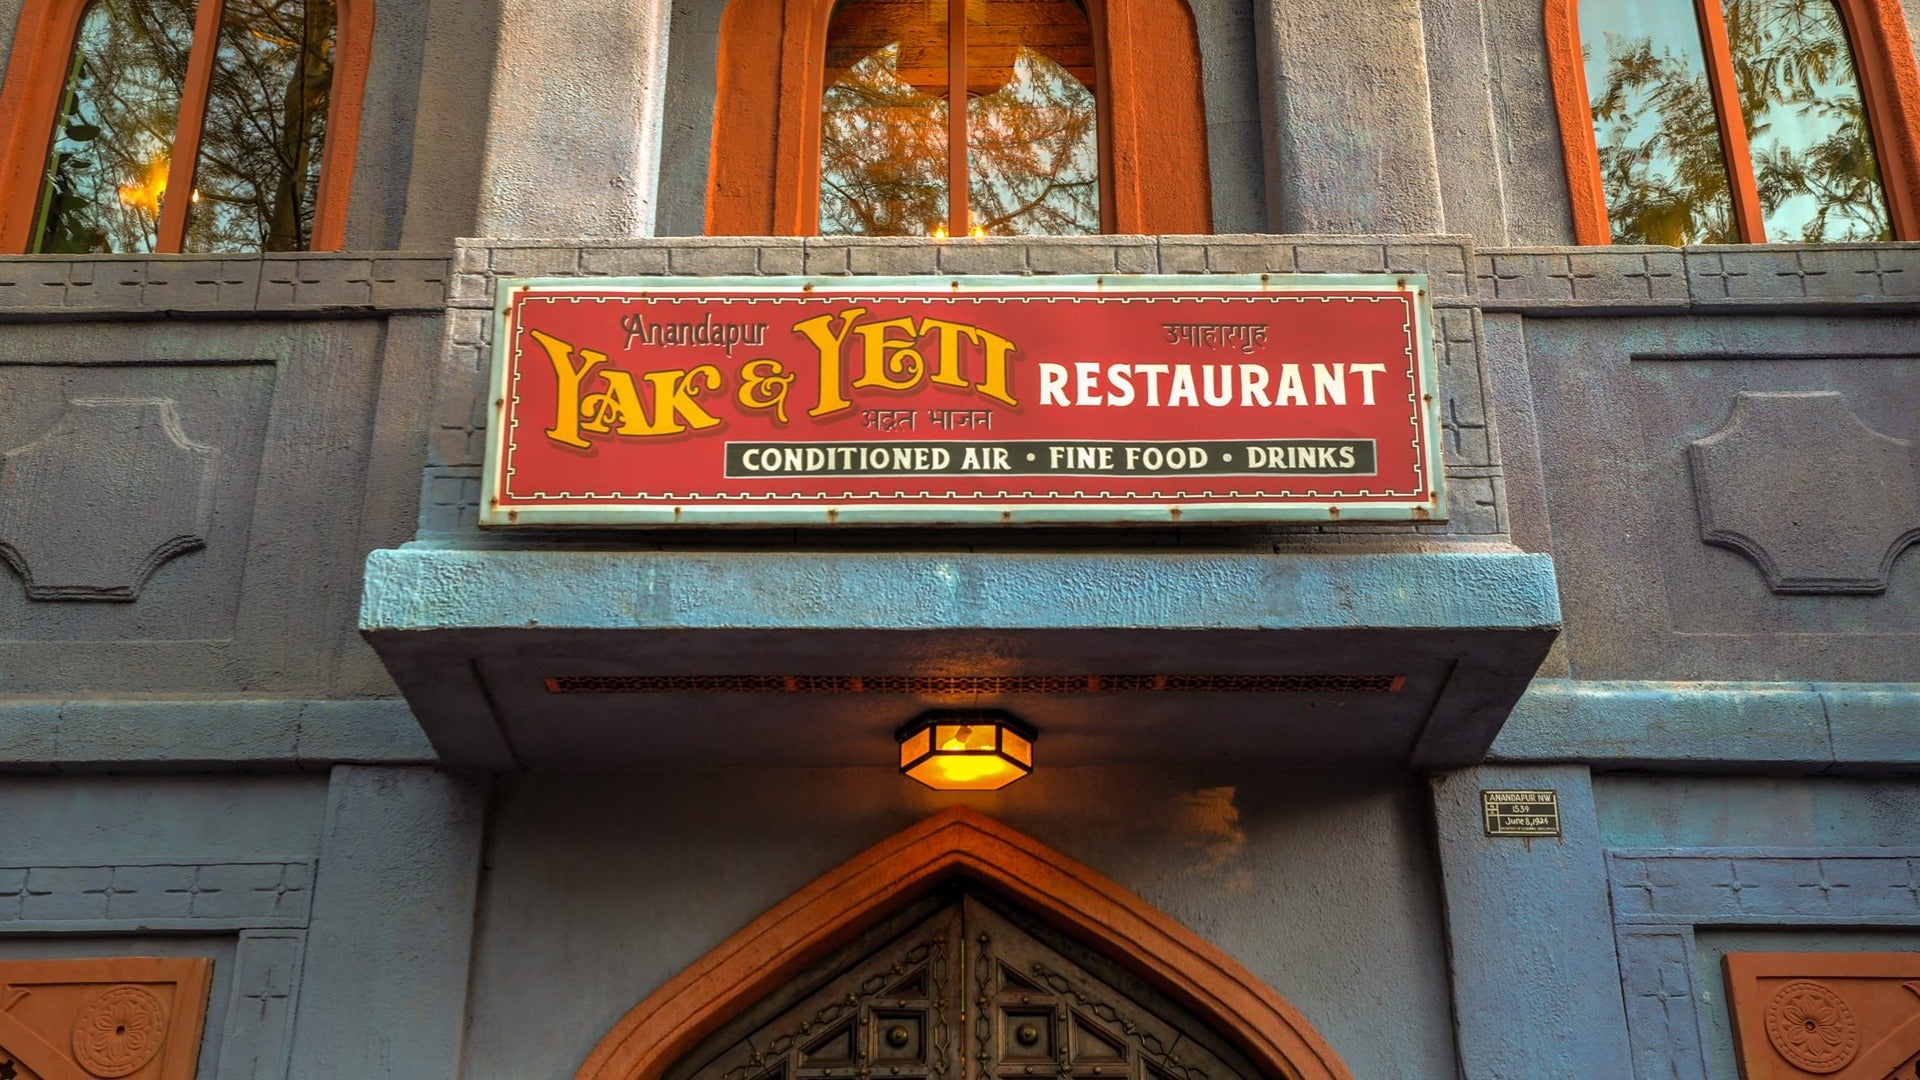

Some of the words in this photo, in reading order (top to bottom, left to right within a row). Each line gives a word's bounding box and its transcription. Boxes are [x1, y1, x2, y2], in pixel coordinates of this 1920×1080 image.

[620, 311, 770, 359] Anandapur
[1161, 323, 1270, 355] उपाहारगृह
[530, 329, 721, 449] YAK
[738, 359, 795, 424] &
[792, 307, 1018, 418] YETI
[1039, 362, 1387, 408] RESTAURANT
[742, 447, 951, 472] CONDITIONED
[960, 447, 1012, 471] AIR
[1049, 446, 1114, 470] FINE
[1125, 446, 1209, 471] FOOD
[1246, 446, 1356, 470] DRINKS
[1489, 794, 1536, 802] ANANDAPUR
[1537, 794, 1551, 802] NW
[1504, 817, 1524, 826] June
